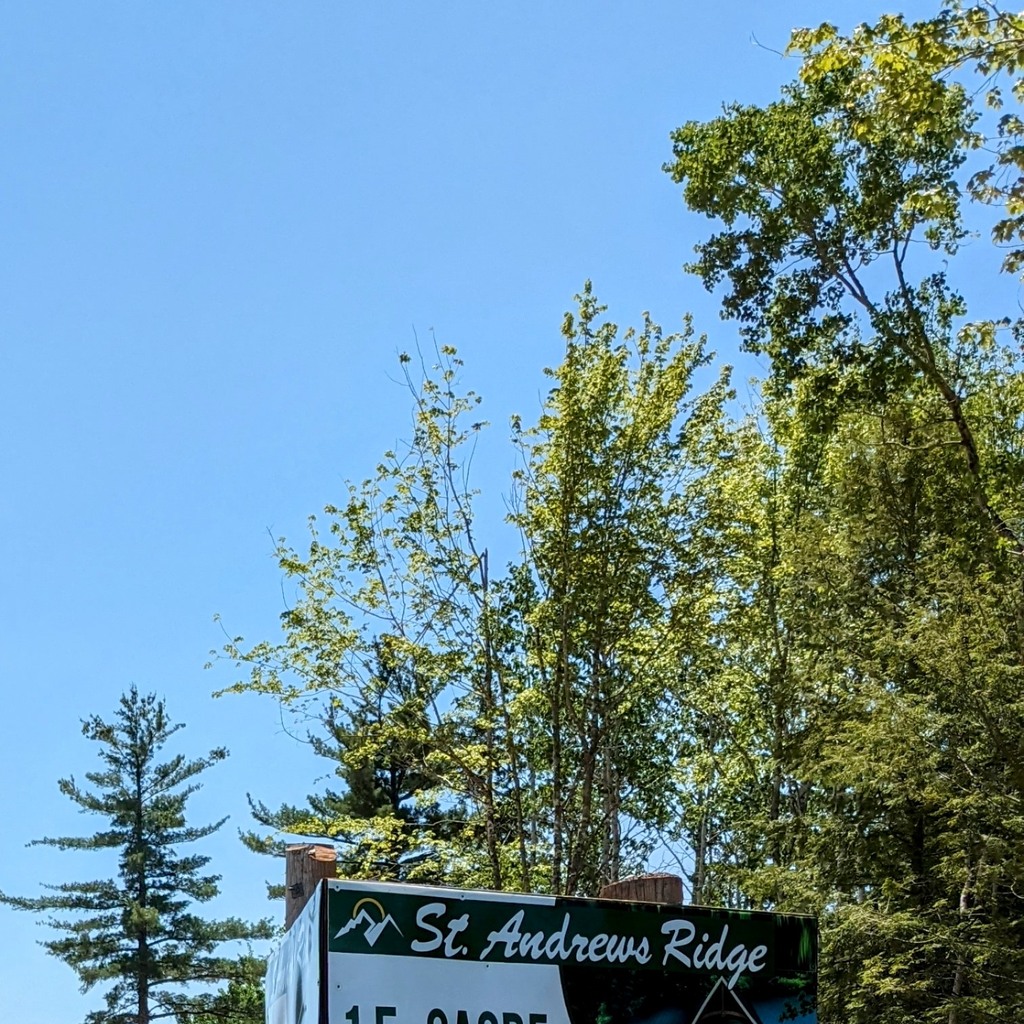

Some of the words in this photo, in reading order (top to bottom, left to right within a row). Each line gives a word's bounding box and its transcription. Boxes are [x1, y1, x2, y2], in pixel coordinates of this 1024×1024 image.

[410, 902, 469, 958] St.
[480, 909, 652, 964] Andrews
[661, 919, 767, 990] Ridge
